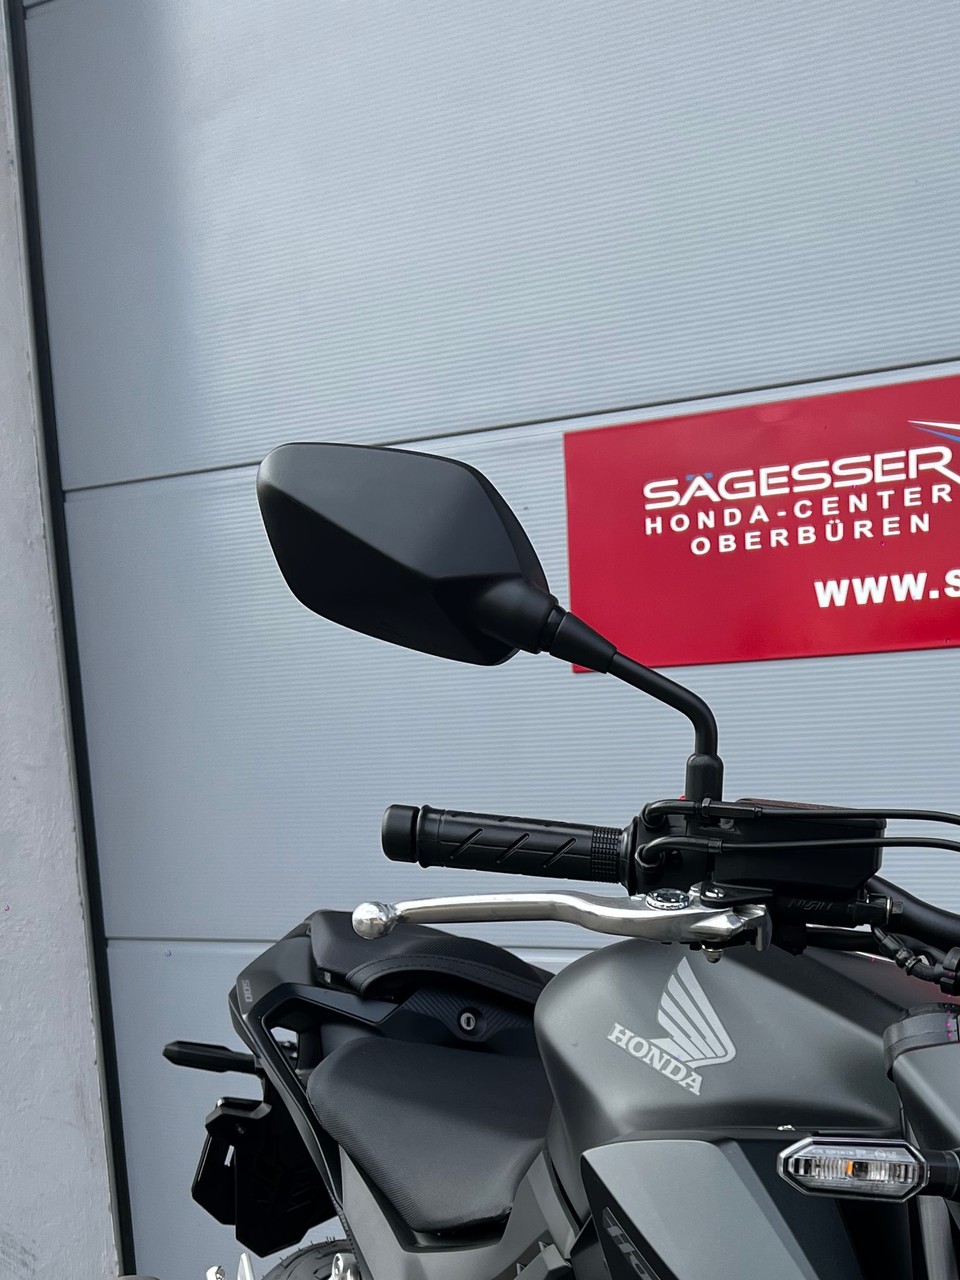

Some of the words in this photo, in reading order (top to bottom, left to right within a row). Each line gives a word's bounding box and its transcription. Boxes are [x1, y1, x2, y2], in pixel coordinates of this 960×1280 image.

[645, 483, 953, 536] HONDA-CENTER
[690, 513, 931, 556] OBERBÜREN
[606, 1022, 703, 1096] HONDA
